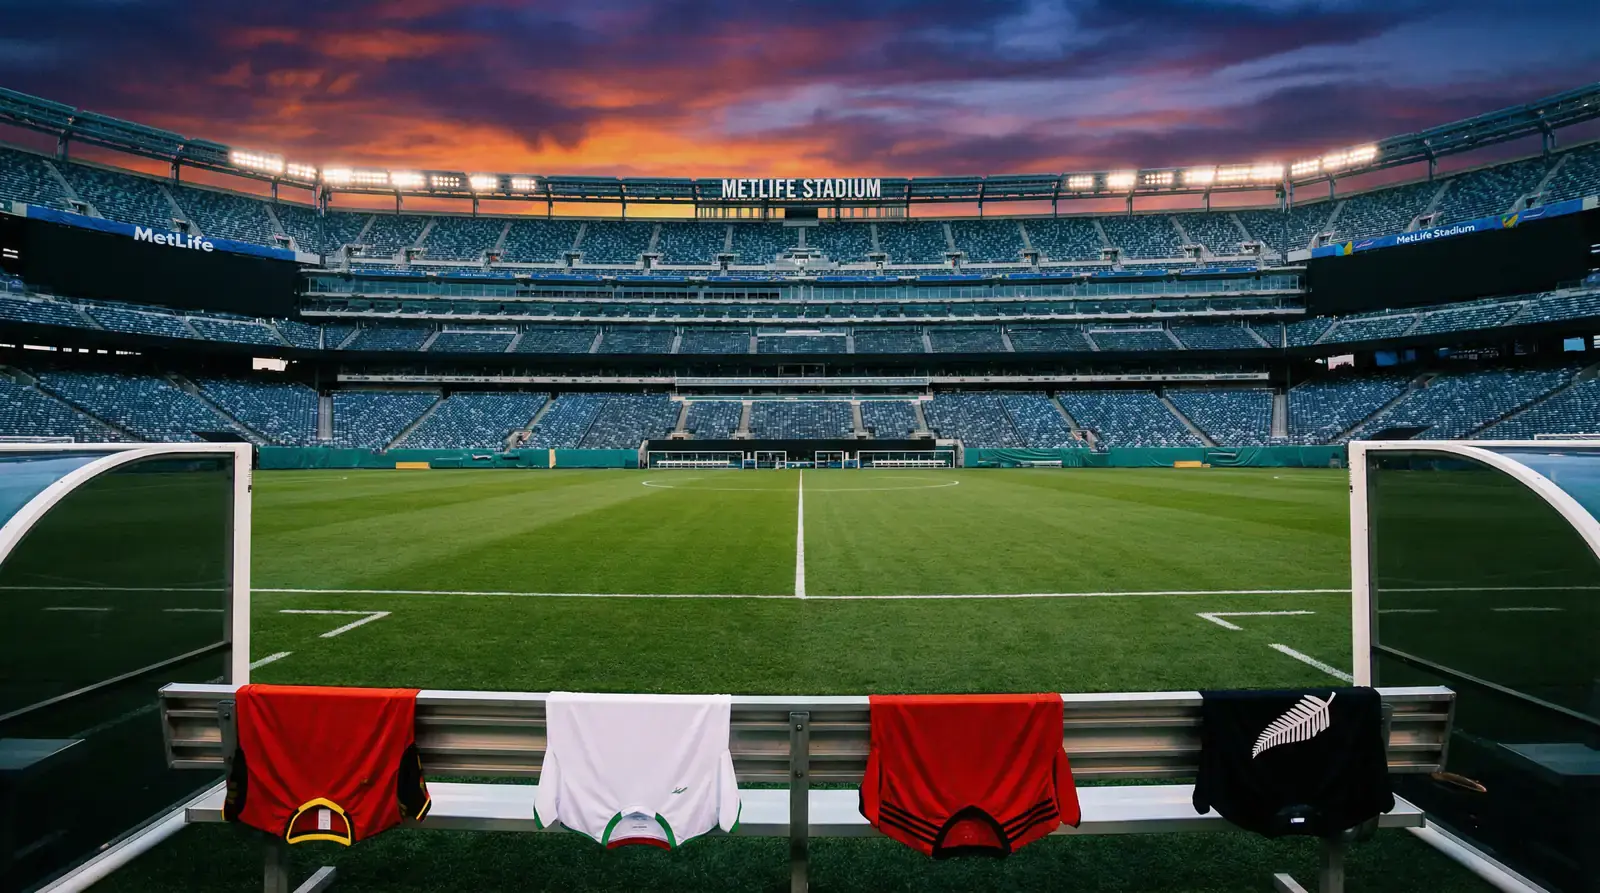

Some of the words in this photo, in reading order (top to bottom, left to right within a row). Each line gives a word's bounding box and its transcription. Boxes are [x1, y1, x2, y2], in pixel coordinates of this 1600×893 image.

[722, 179, 796, 198] METLIFE
[802, 178, 881, 198] STADIUM
[133, 225, 214, 253] MetLife
[1396, 231, 1432, 245] MetLife
[1433, 224, 1475, 238] Stadium
